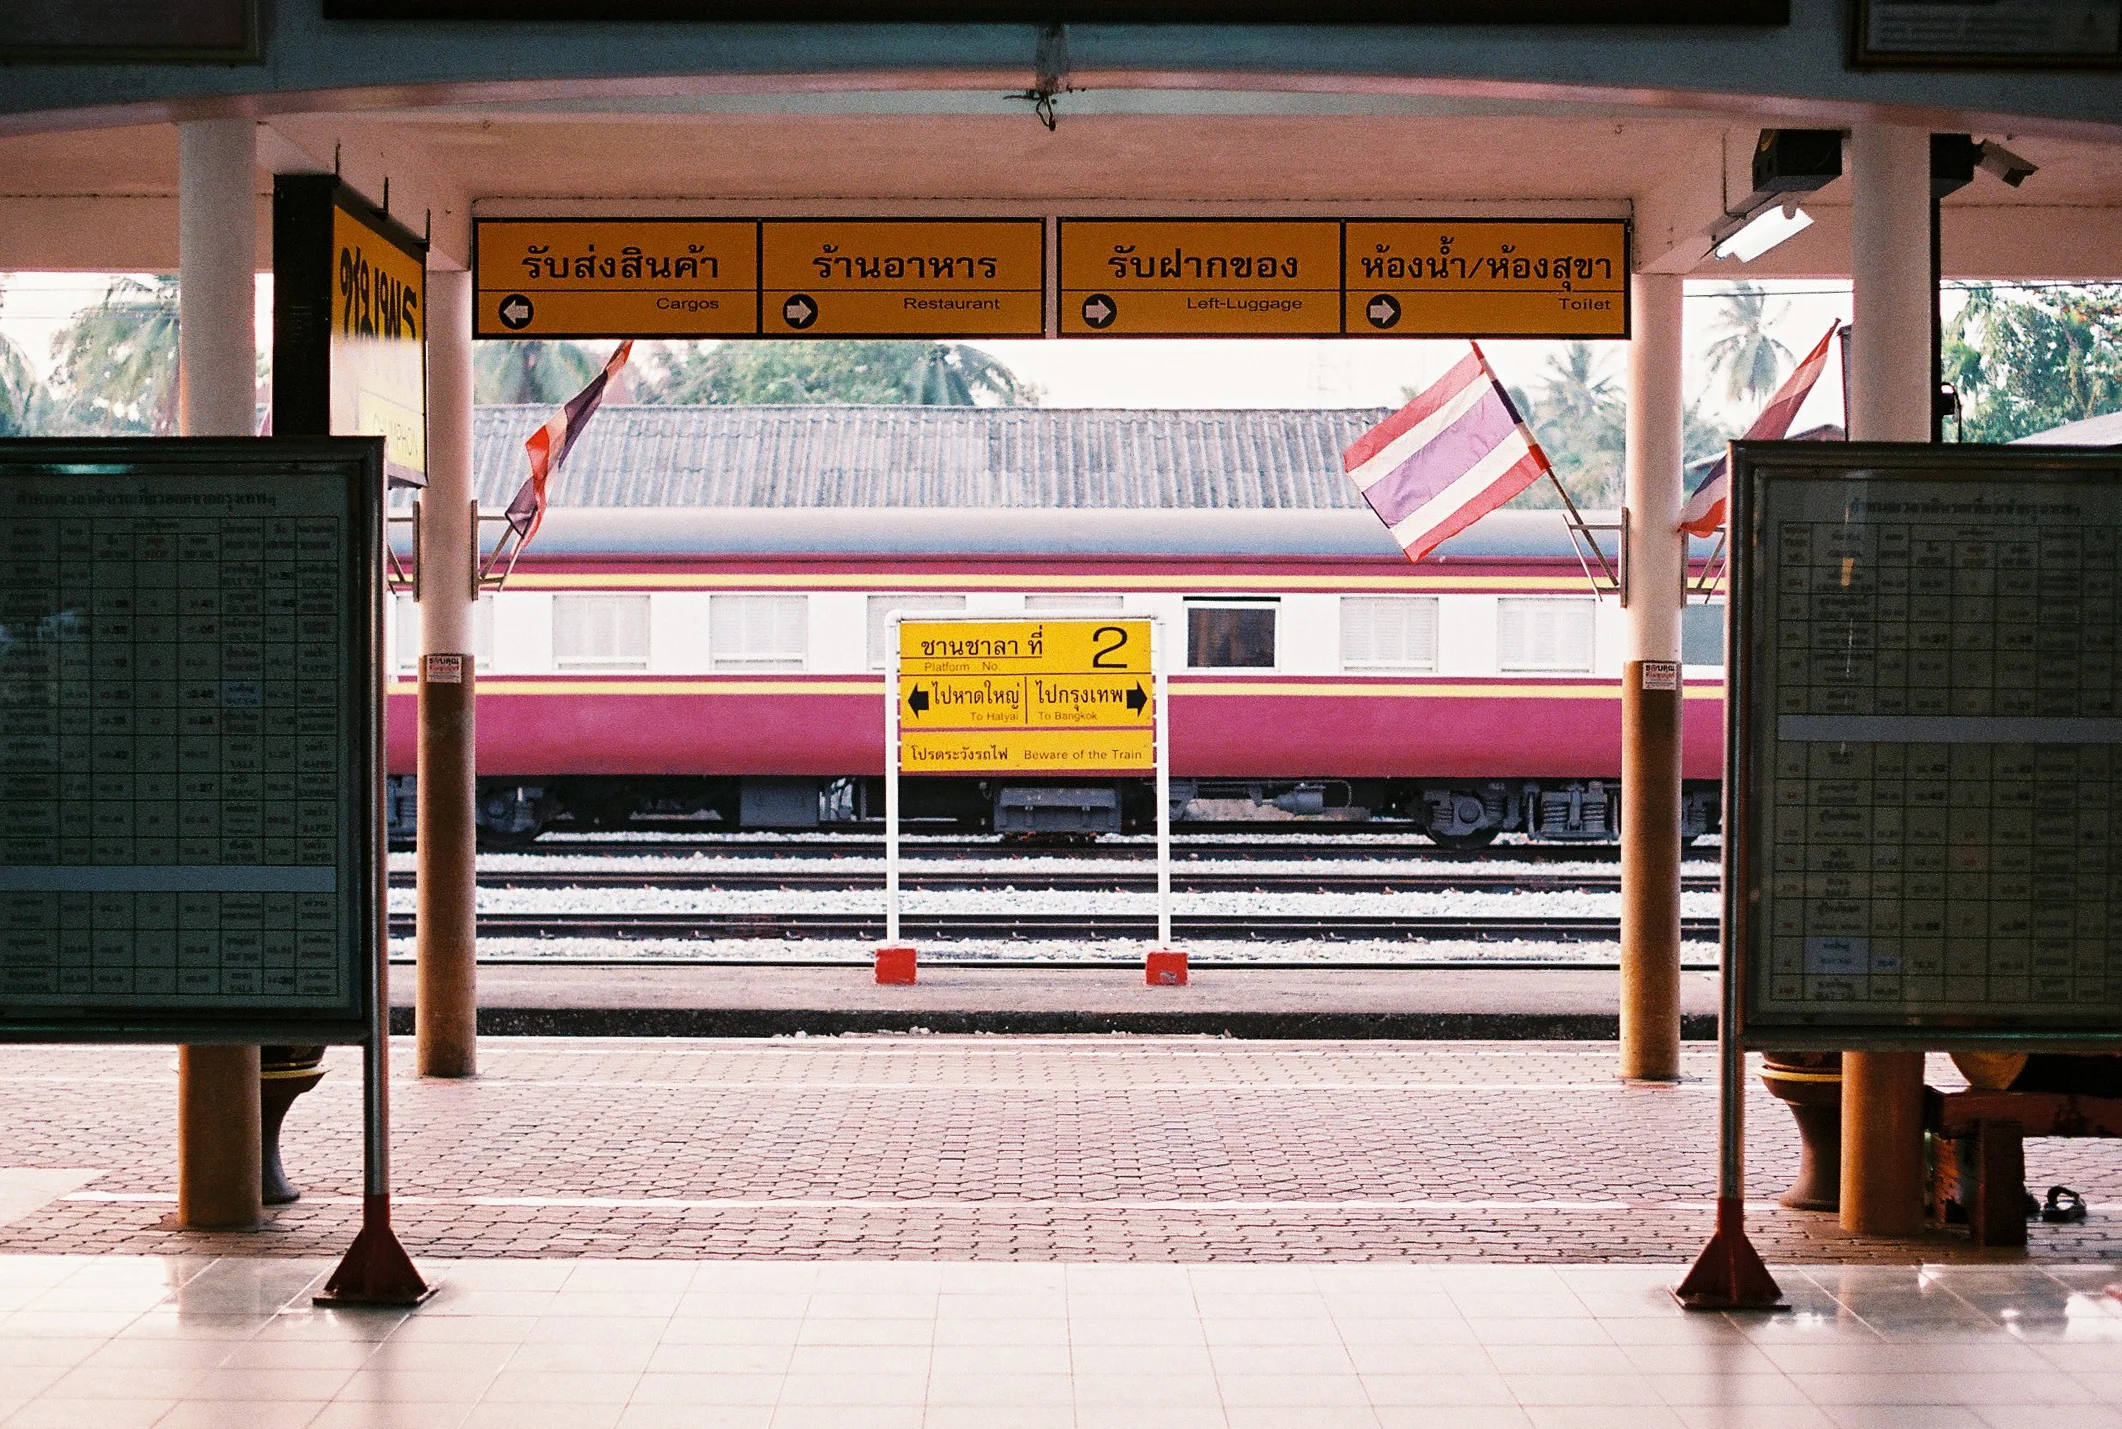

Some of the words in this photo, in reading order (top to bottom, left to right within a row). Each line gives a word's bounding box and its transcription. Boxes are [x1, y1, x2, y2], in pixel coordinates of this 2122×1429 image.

[523, 245, 717, 278] รับส่งสินค้า
[813, 244, 996, 278] ร้านอาหาร
[1109, 246, 1297, 278] รับฝากของ
[1361, 236, 1610, 291] ห้องน้ำ/ห้องสุขา
[657, 298, 718, 312] Cargos
[904, 298, 998, 309] Restaurant
[1188, 298, 1302, 311] Left-Luggage
[1559, 298, 1610, 310] Toilet
[921, 640, 1018, 656] ชานชาลา
[1028, 625, 1042, 654] ที่
[1093, 627, 1127, 668] 2
[924, 662, 970, 672] Platform
[932, 680, 1019, 709] ไปหาดใหญ่
[1036, 680, 1122, 711] ไปกรุงเทพ
[970, 712, 983, 721] To
[1038, 712, 1051, 720] To
[1054, 712, 1098, 722] Bangkok
[1024, 750, 1068, 760] Beware
[1072, 750, 1084, 760] of
[1088, 750, 1107, 760] the
[1112, 750, 1142, 760] Train
